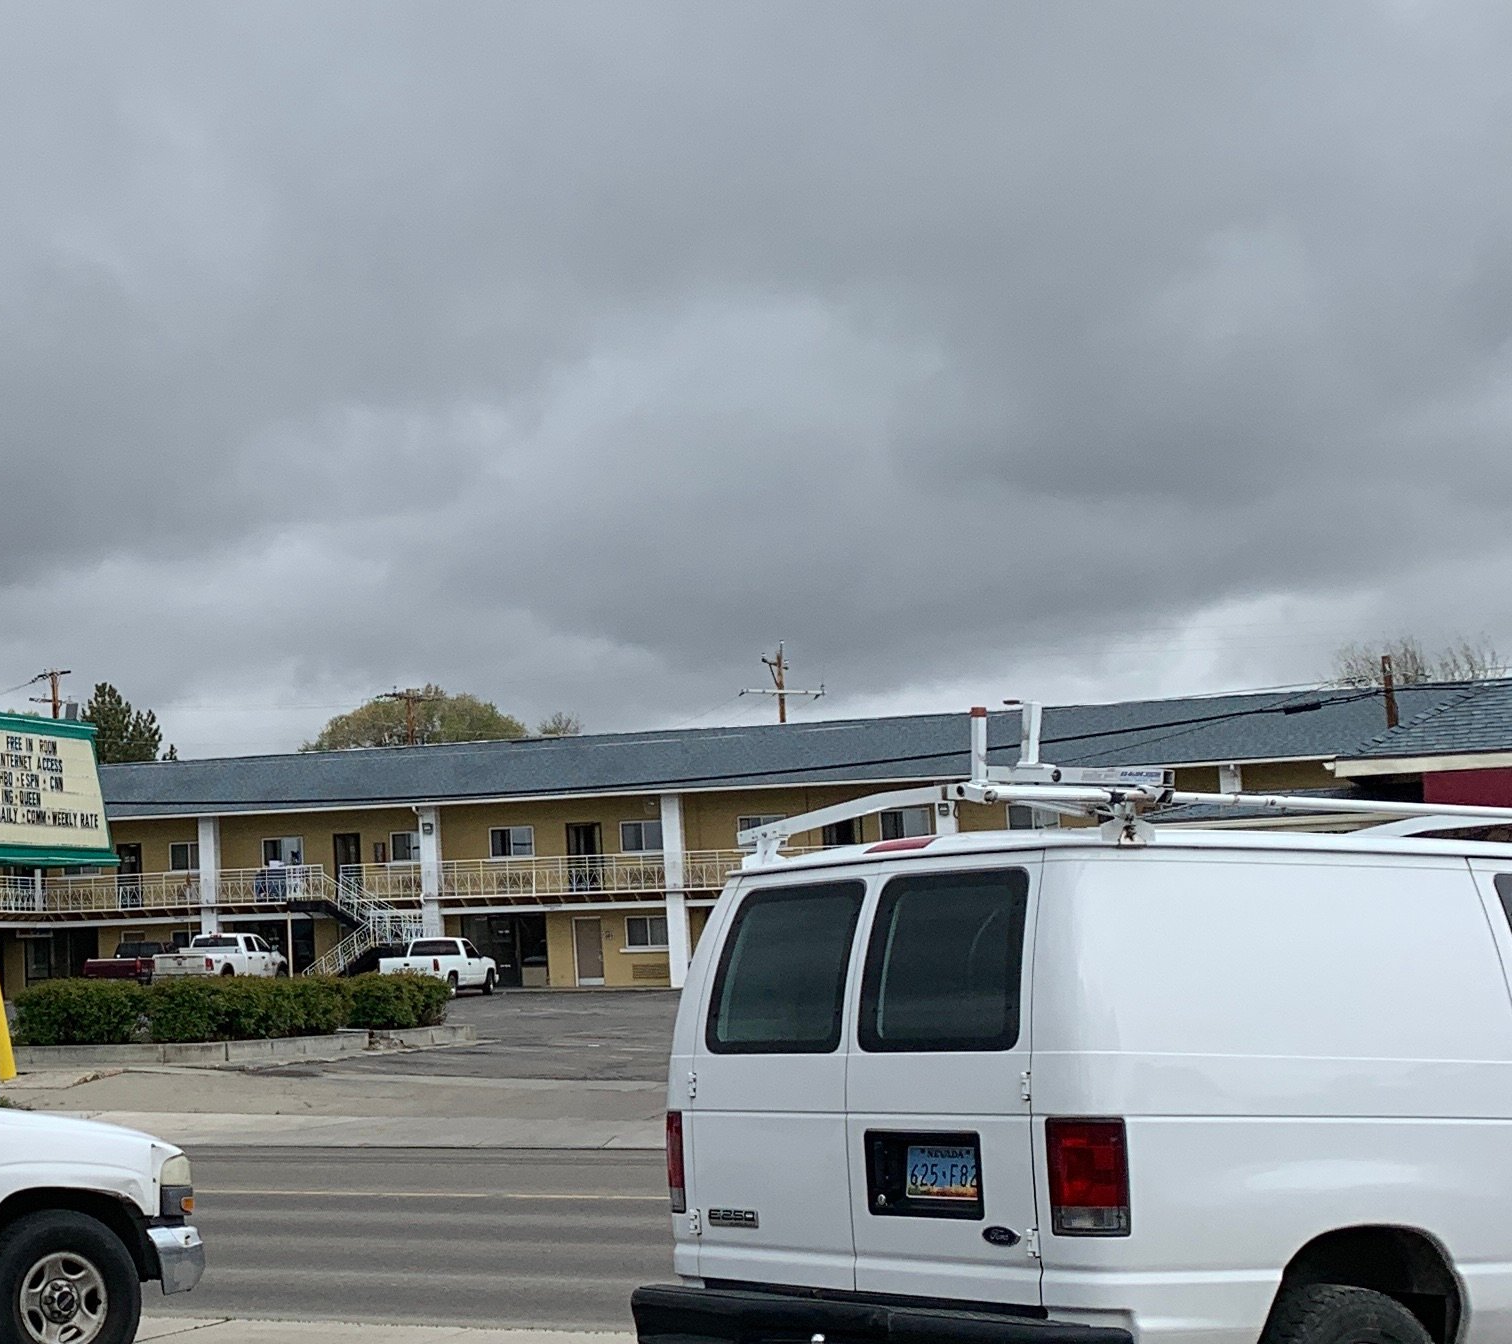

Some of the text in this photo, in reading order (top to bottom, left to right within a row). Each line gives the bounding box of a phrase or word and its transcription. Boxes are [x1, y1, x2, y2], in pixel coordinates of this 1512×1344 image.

[7, 735, 57, 755] FREE IN ROOM
[37, 757, 63, 773] ACCESS
[21, 772, 40, 788] ESPN
[50, 776, 63, 792] CNN
[19, 790, 41, 806] QUEEN
[26, 809, 46, 824] COMM
[52, 811, 77, 826] WEEKLY
[80, 813, 98, 828] RATE
[928, 1150, 964, 1159] NEVADA
[910, 1163, 938, 1187] 625
[708, 1208, 755, 1222] E250
